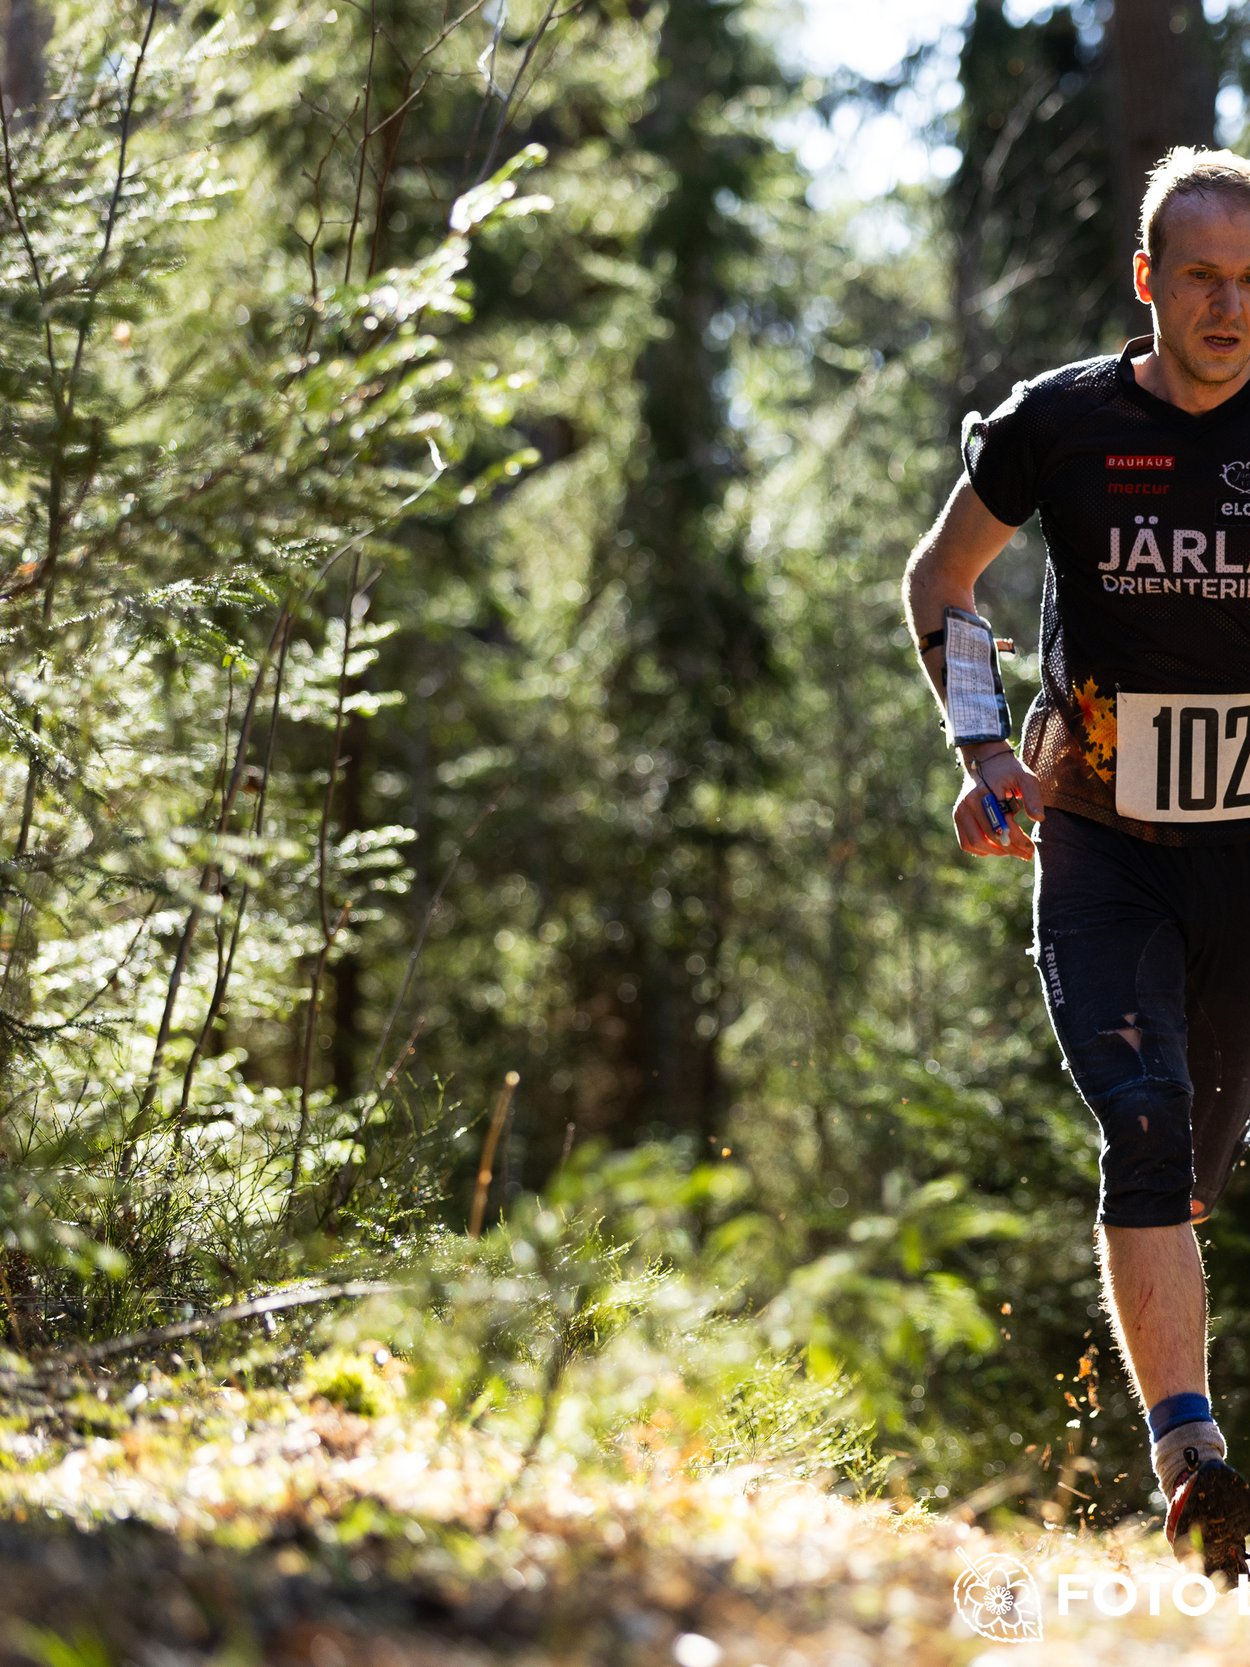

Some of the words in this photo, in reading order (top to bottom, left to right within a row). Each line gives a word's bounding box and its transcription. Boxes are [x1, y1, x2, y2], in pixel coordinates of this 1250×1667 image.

[1108, 458, 1173, 467] BAUHAUS
[1107, 482, 1170, 495] mercur
[1044, 943, 1066, 1008] TRIMTEX
